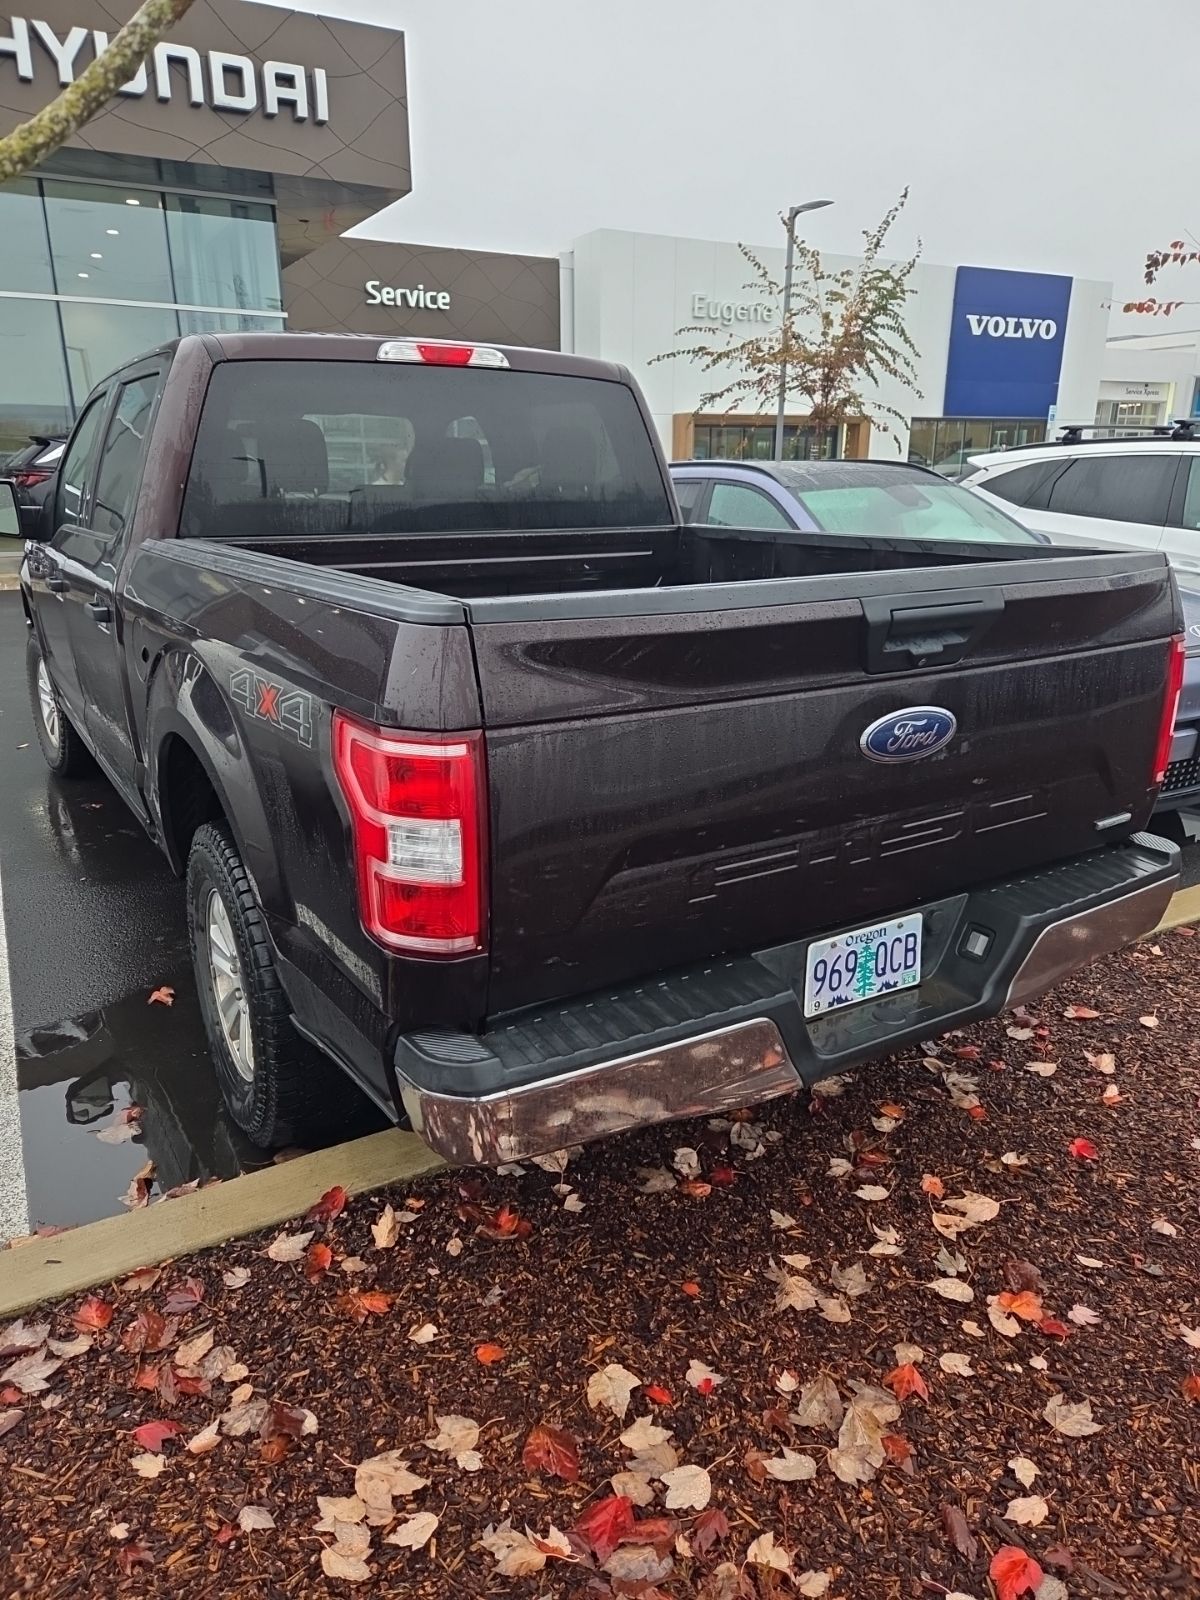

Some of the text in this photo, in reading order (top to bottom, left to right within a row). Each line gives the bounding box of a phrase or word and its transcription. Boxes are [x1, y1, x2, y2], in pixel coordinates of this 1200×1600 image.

[365, 280, 451, 310] Service
[692, 294, 774, 327] Eugene
[966, 314, 1057, 340] VOLVO
[887, 719, 939, 752] Ford
[846, 928, 887, 946] Oregon
[813, 932, 917, 996] 969 QCB
[814, 1001, 821, 1011] 9
